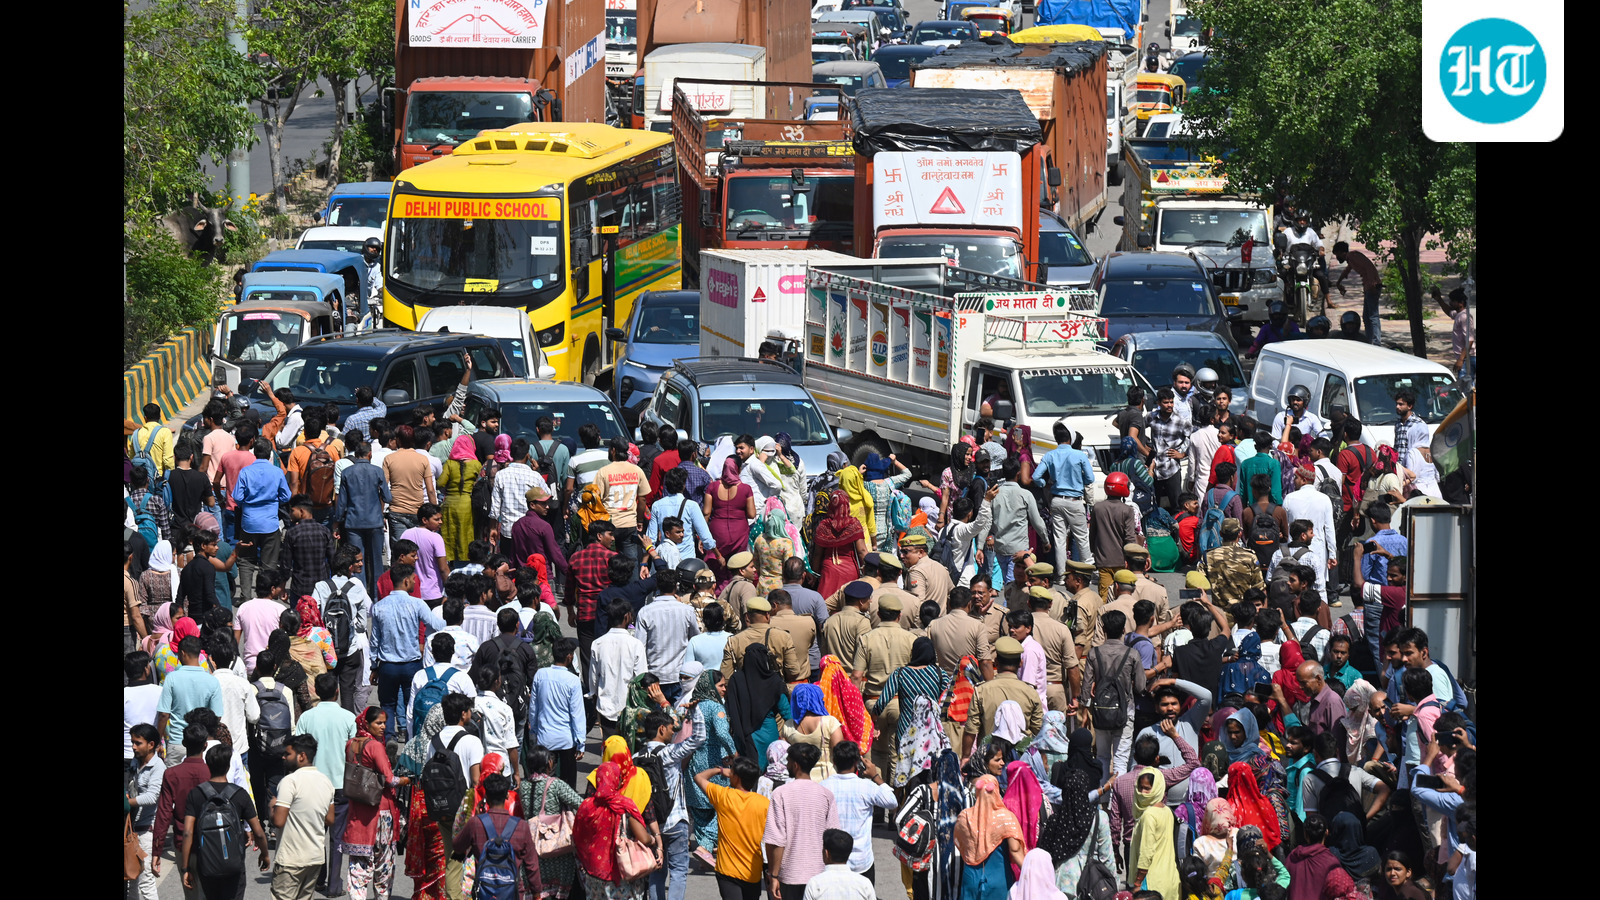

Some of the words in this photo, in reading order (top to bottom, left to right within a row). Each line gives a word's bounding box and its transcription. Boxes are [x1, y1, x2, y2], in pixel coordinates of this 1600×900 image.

[411, 0, 420, 8] N
[534, 0, 543, 8] P
[410, 35, 432, 43] GOODS
[885, 190, 904, 207] श्री
[984, 188, 1004, 202] श्री
[405, 201, 441, 216] DELHI
[445, 202, 491, 217] PUBLIC
[495, 202, 548, 218] SCHOOL
[884, 205, 904, 218] राधे
[983, 204, 1004, 217] राधे
[994, 299, 1010, 310] जय
[1013, 298, 1038, 310] माता
[1042, 294, 1054, 309] दी
[1021, 369, 1045, 377] ALL
[1049, 368, 1081, 376] INDIA
[1084, 366, 1129, 375] PERMIT
